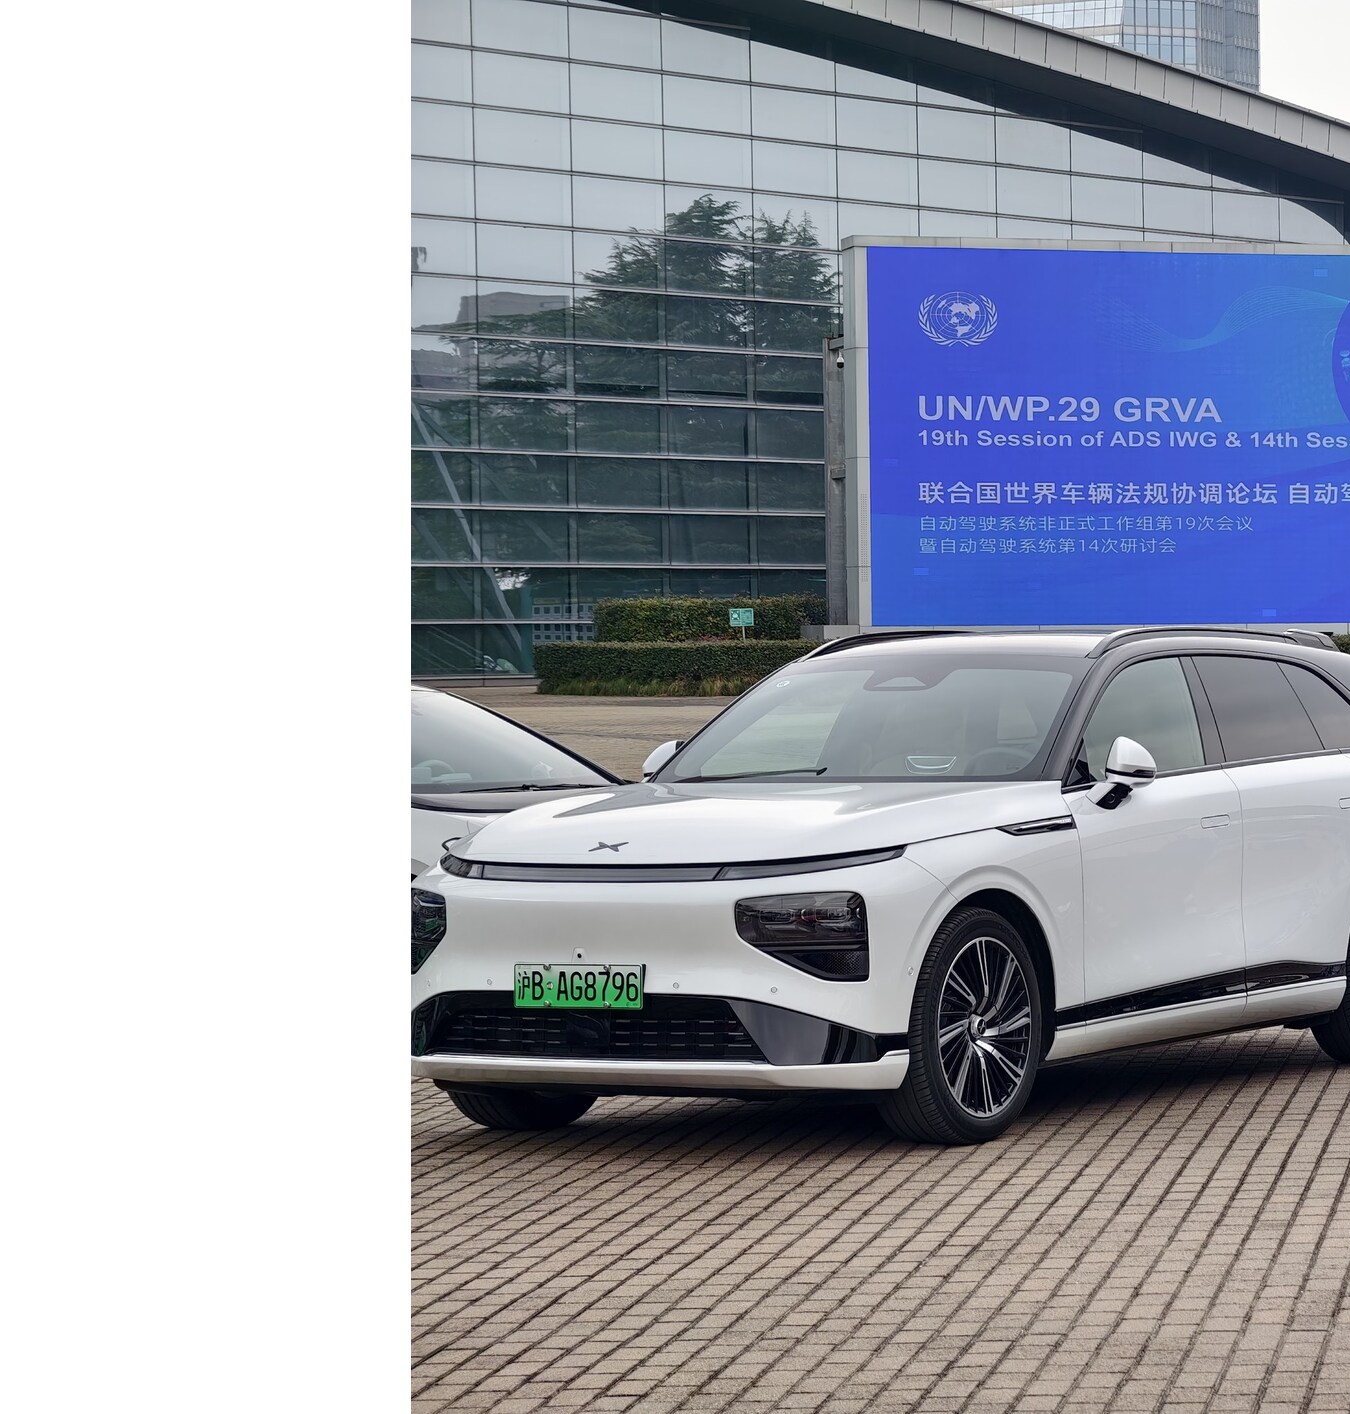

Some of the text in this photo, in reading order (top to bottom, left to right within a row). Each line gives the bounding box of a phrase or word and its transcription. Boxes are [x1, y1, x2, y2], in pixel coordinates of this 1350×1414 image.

[918, 395, 1223, 423] UN/WP.29 GRVA
[918, 429, 968, 447] 19th
[976, 429, 1072, 447] Session
[1080, 429, 1105, 447] of
[1109, 430, 1162, 448] ADS
[1169, 431, 1217, 448] IWG
[1225, 431, 1243, 448] &
[1249, 431, 1298, 448] 14th
[918, 481, 1279, 506] 联合国世界车辆法规协调论坛
[919, 515, 1254, 533] 自动驾驶系统非正式工作组第19次会议
[919, 537, 1178, 555] 暨自动驾驶系统第14次研讨会
[556, 970, 640, 1002] AG8796
